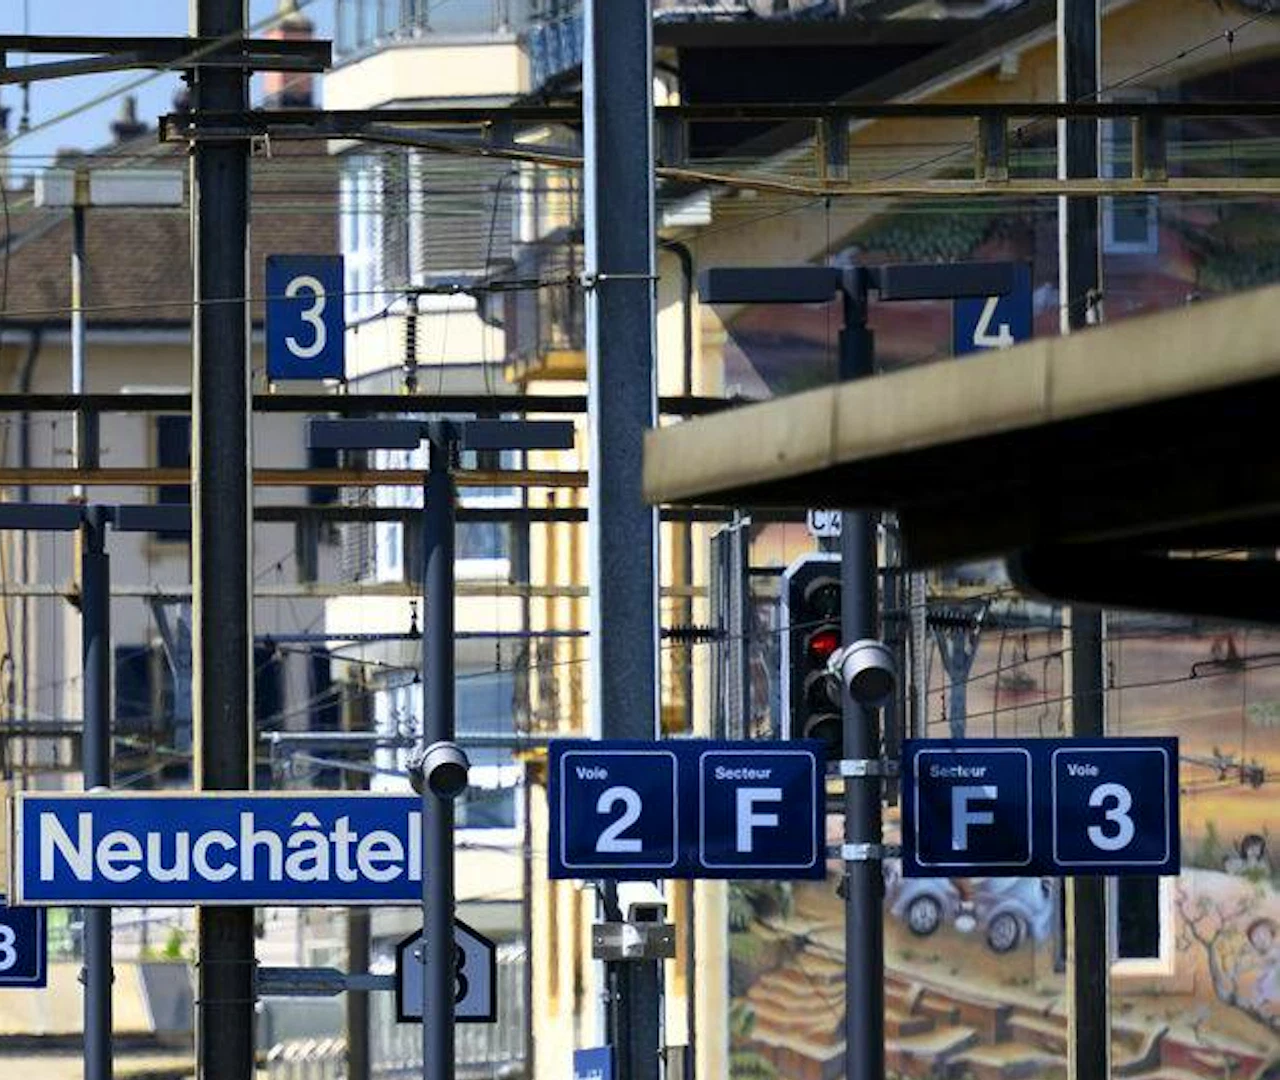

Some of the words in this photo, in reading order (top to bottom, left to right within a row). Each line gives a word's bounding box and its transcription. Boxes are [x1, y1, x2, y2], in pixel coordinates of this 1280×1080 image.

[284, 275, 326, 358] 3
[973, 296, 1015, 347] 4
[575, 765, 609, 780] Voie
[715, 765, 773, 781] Secteur
[929, 763, 988, 779] Secteur
[1066, 762, 1100, 778] Voie
[39, 811, 422, 883] Neuchâtel
[594, 786, 644, 853] 2
[735, 787, 784, 854] F
[950, 785, 998, 852] F
[1086, 782, 1136, 852] 3
